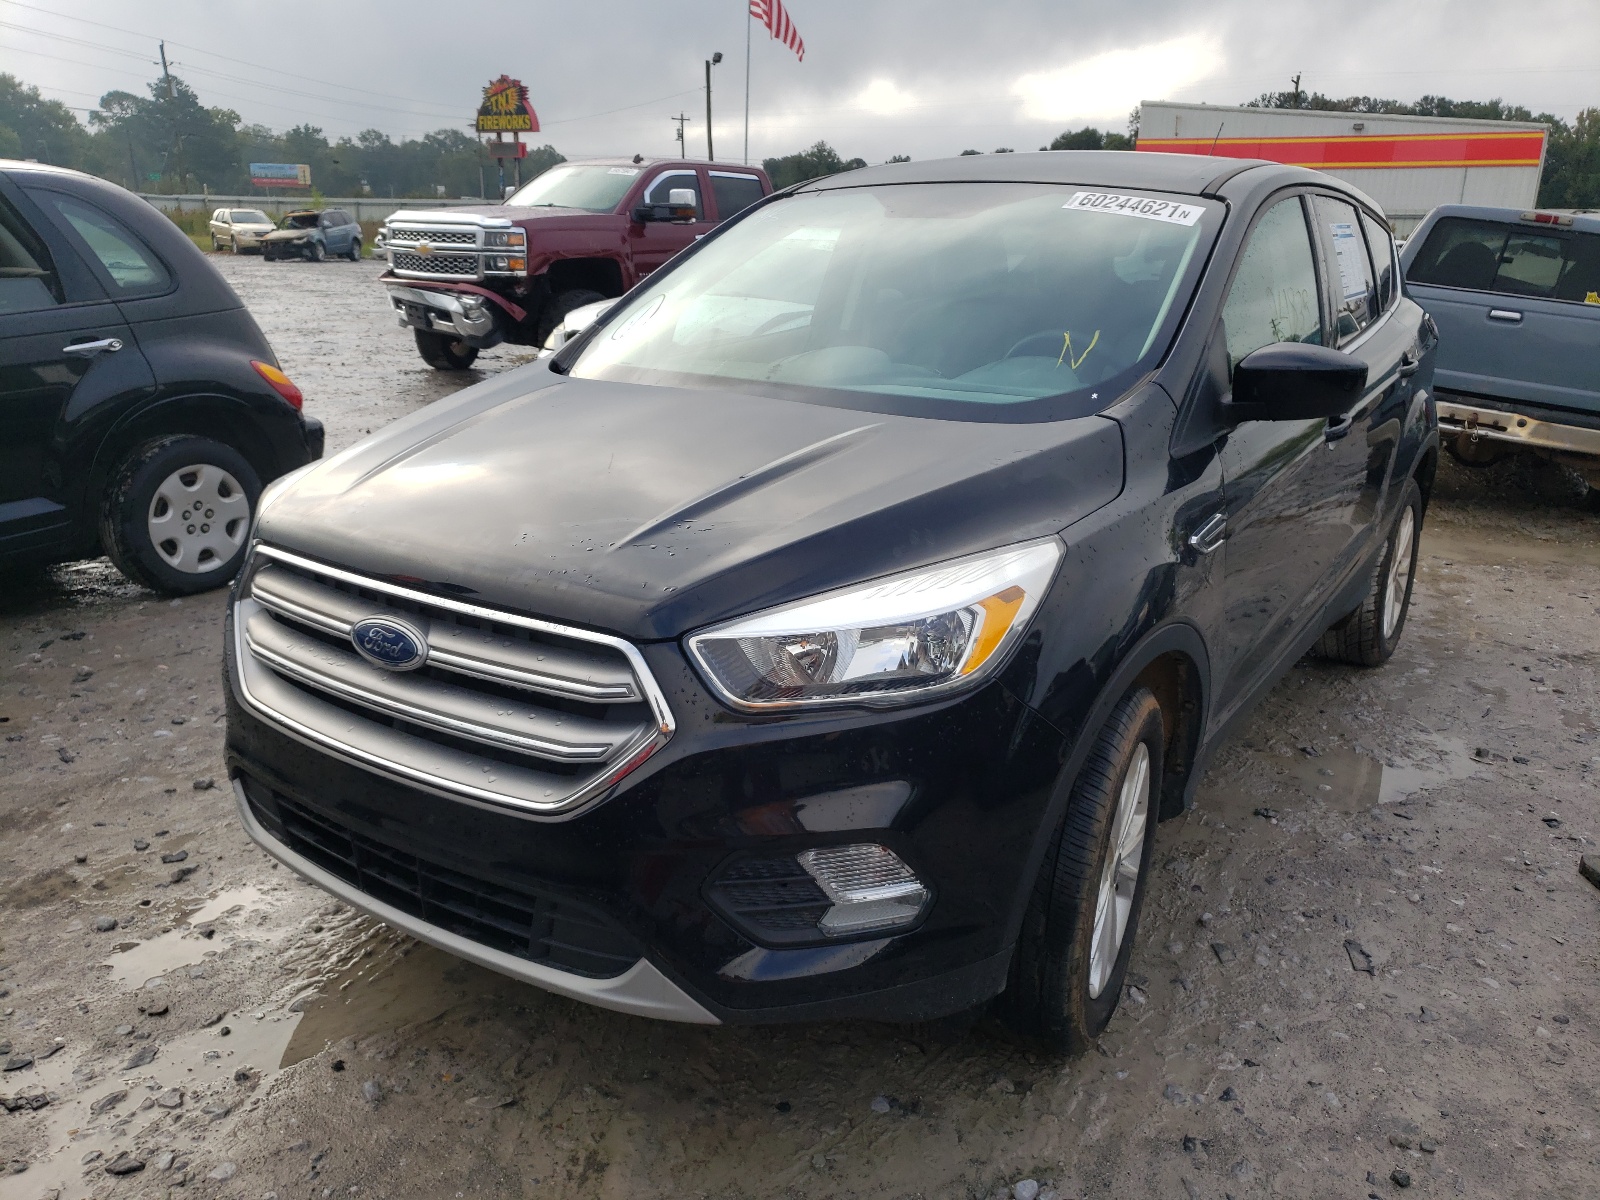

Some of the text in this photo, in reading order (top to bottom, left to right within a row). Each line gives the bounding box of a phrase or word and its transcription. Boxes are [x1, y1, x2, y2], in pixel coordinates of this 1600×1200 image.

[489, 88, 514, 112] TNT
[478, 115, 532, 130] FIREWORKS
[1078, 193, 1191, 219] 60244621 N
[364, 627, 404, 658] Ford
